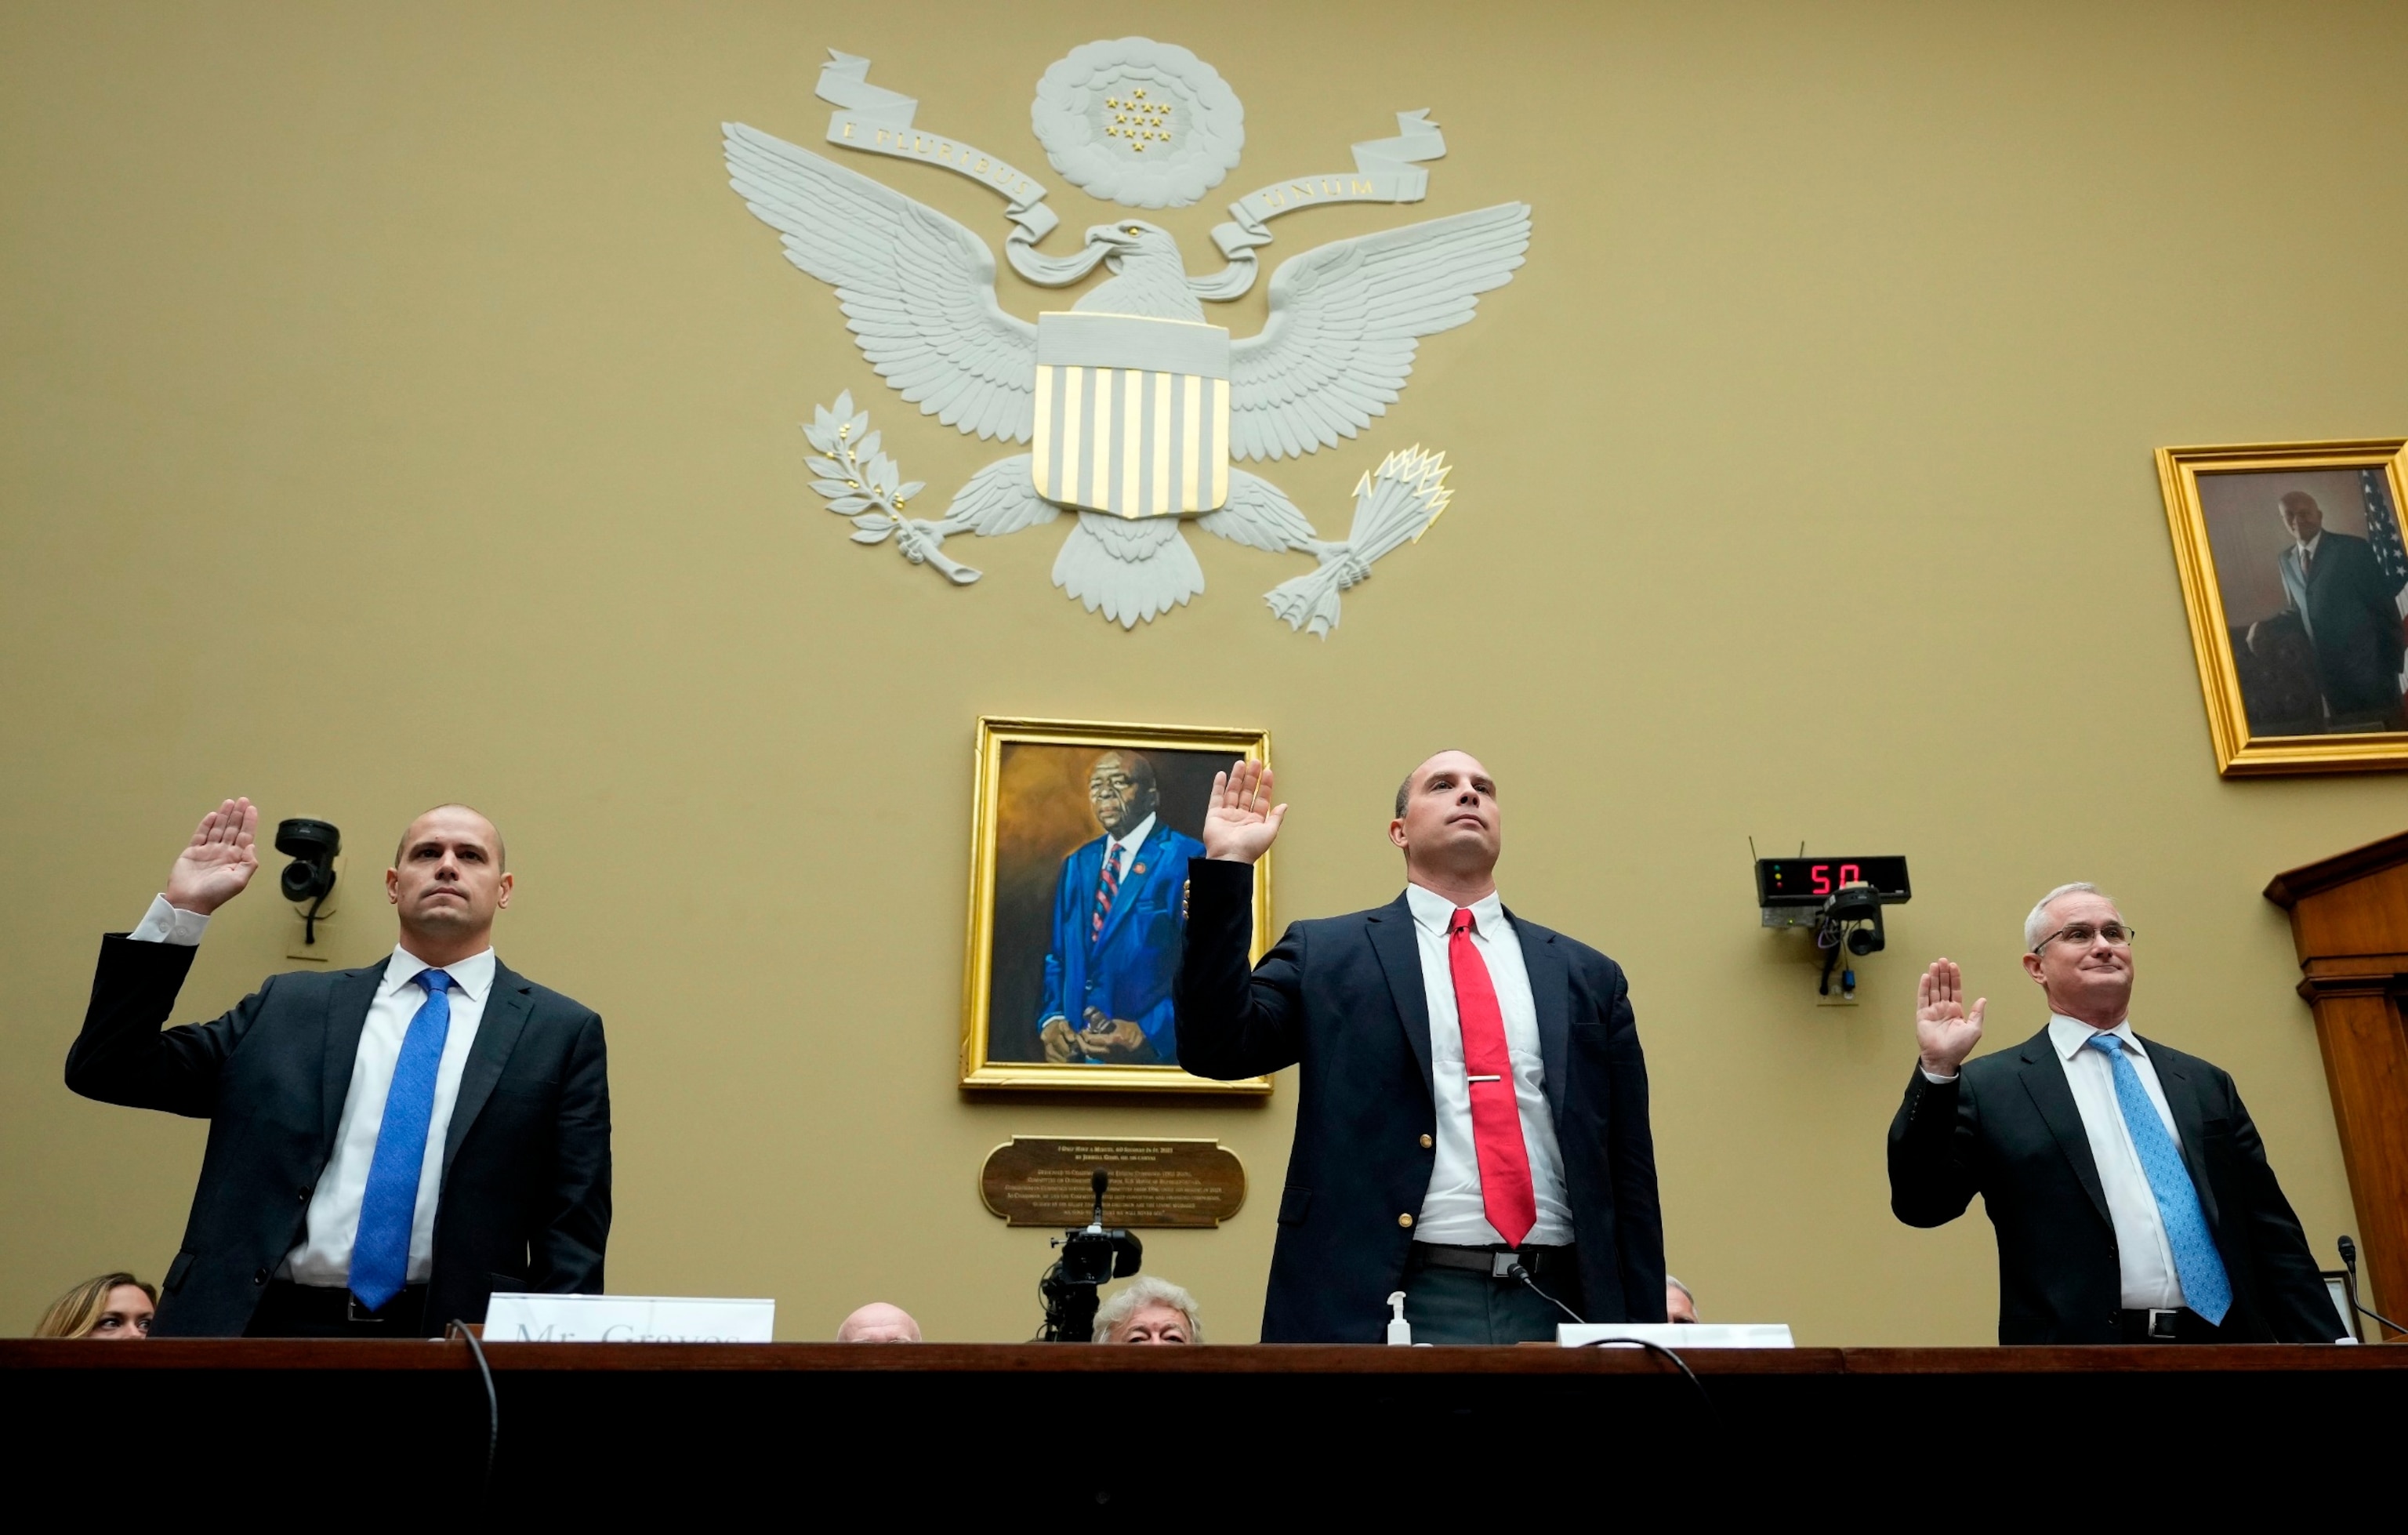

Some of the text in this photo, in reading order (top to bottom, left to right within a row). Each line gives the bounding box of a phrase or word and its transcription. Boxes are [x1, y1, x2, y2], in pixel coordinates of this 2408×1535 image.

[843, 122, 1031, 195] E PLURIBUS
[1262, 178, 1373, 208] UNUM
